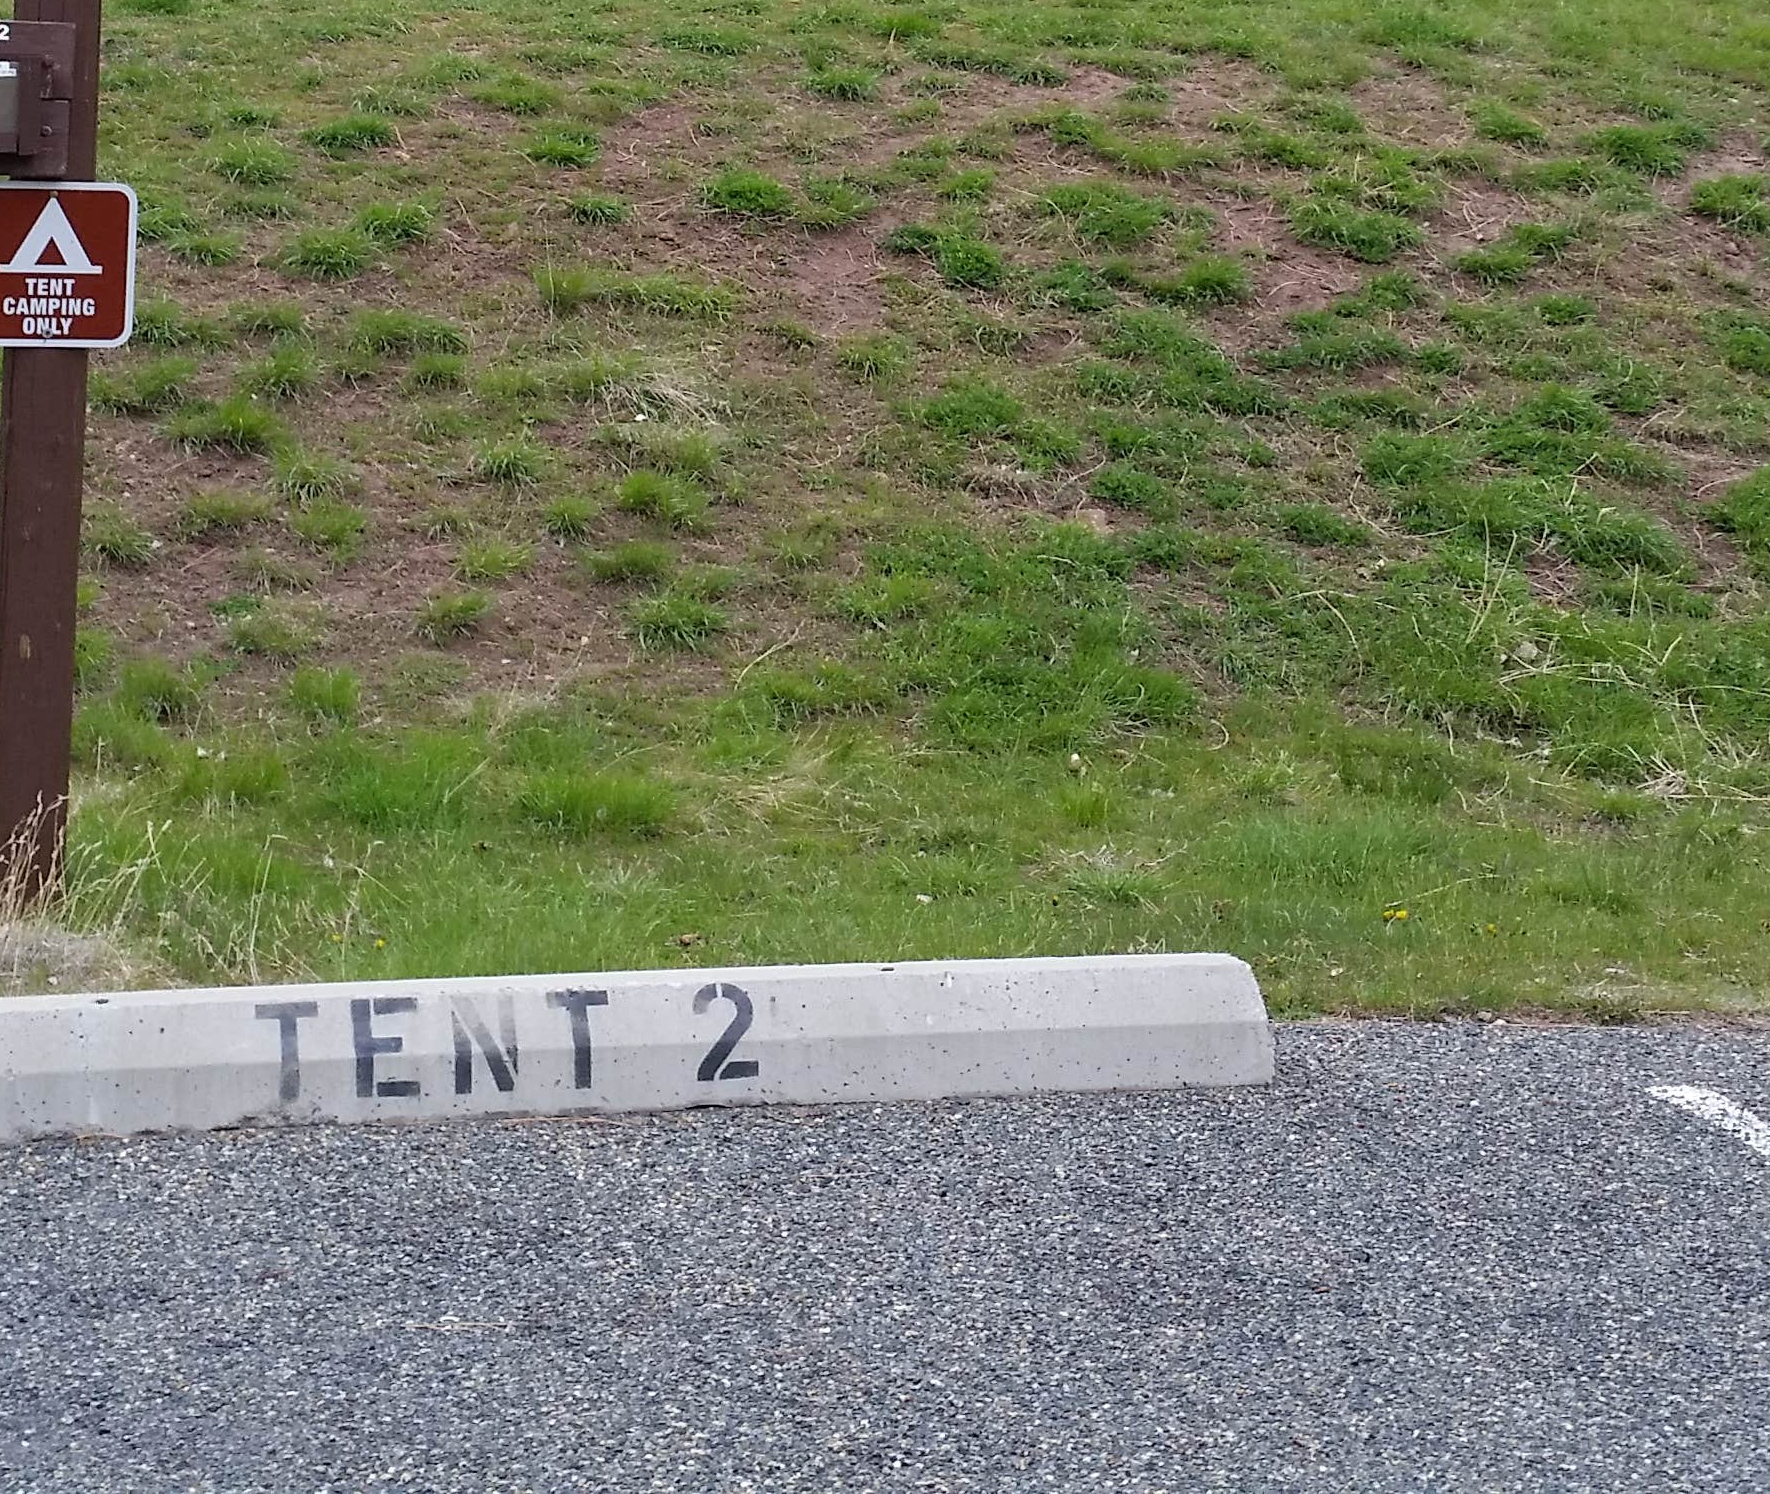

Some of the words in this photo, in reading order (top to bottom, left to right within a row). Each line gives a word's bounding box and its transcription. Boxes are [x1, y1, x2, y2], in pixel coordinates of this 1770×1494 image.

[25, 277, 76, 296] TENT
[2, 297, 96, 316] CAMPING
[22, 316, 73, 336] ONLY
[254, 989, 609, 1103] TENT
[692, 982, 759, 1082] 2
